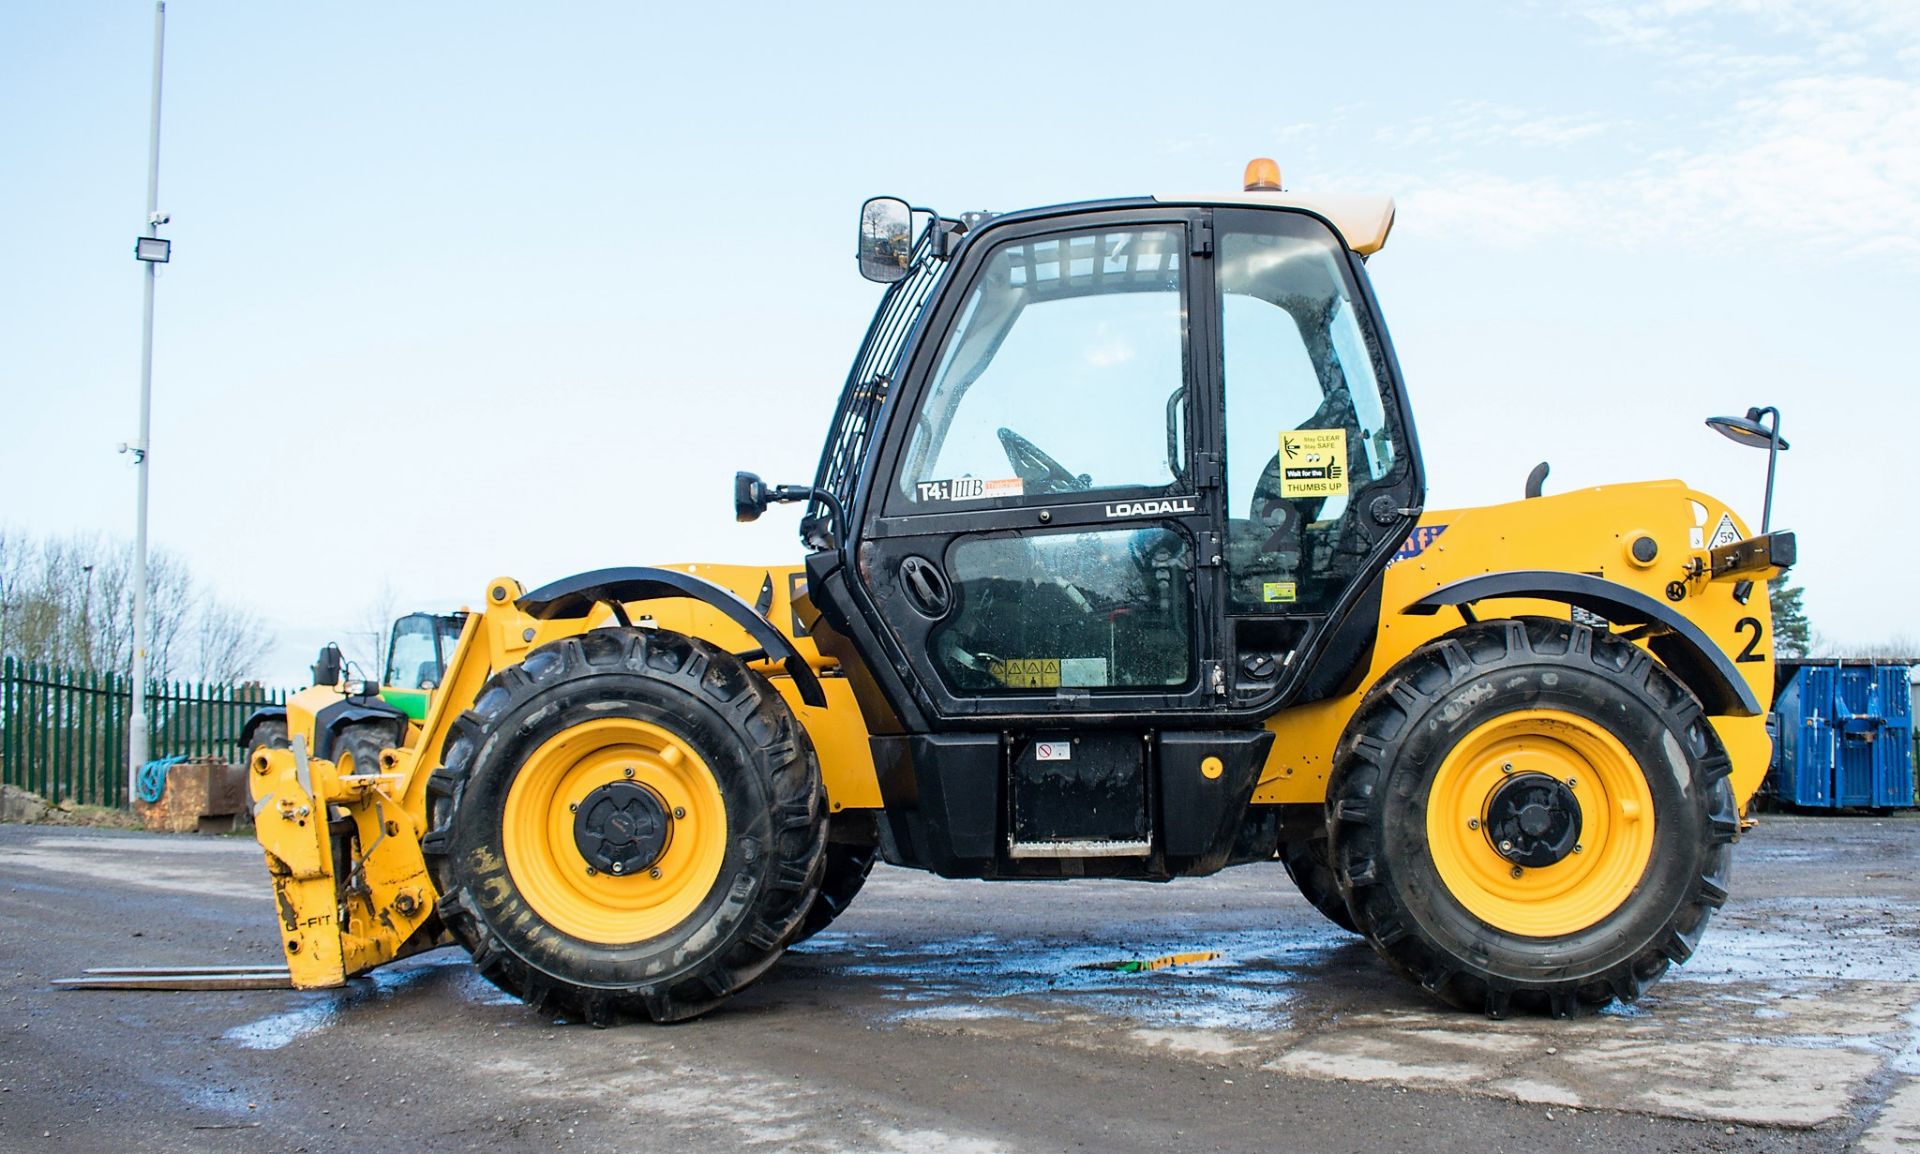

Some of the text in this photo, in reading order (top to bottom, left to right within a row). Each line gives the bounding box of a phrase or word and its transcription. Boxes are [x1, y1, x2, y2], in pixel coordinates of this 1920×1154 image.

[1317, 434, 1340, 442] CLEAR
[917, 481, 951, 501] T4i
[1288, 482, 1342, 492] THUMBS UP
[1105, 499, 1195, 518] LOADALL
[1262, 498, 1298, 553] 2
[1720, 531, 1735, 544] 59
[1734, 616, 1765, 663] 2
